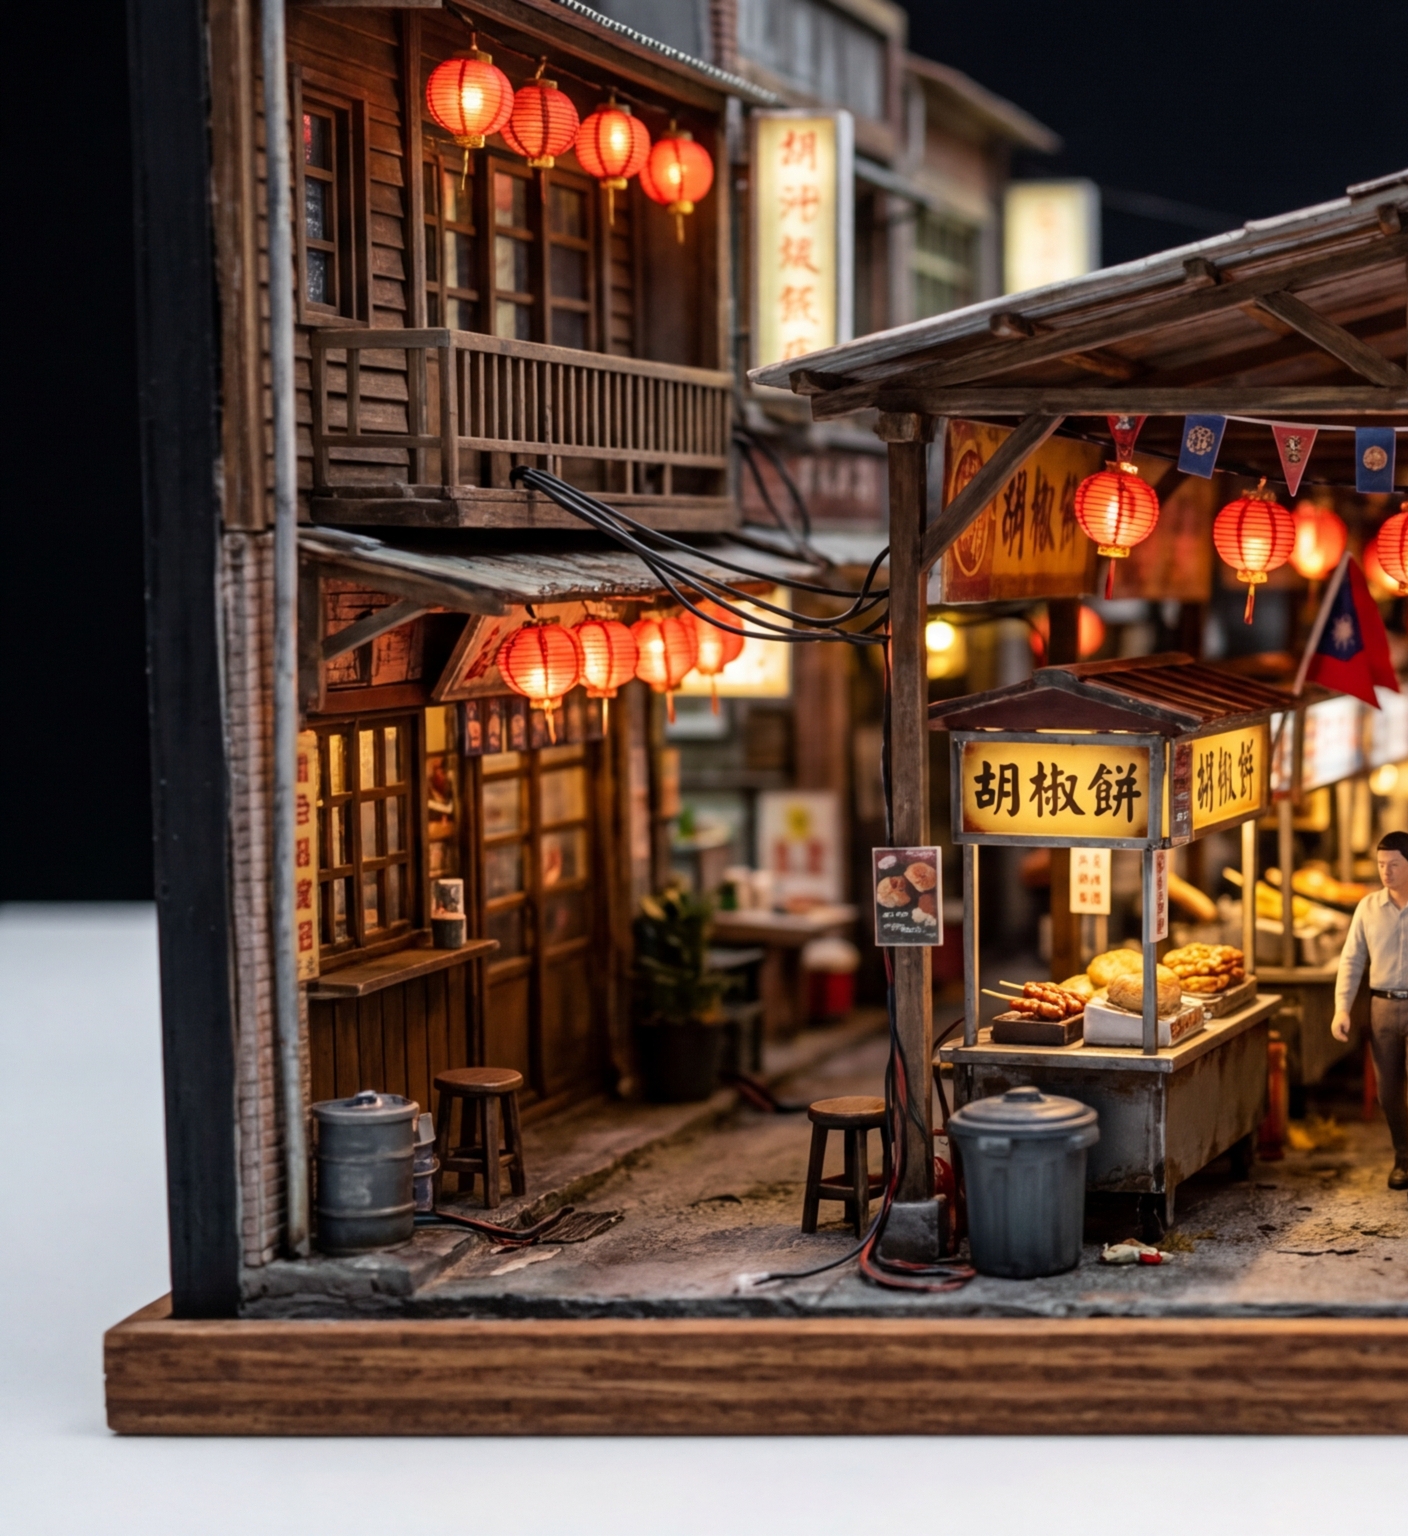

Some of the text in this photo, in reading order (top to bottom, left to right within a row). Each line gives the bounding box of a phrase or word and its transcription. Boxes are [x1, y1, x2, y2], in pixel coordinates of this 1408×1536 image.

[973, 760, 1142, 823] 胡椒餅
[1197, 738, 1254, 813] 胡椒餅
